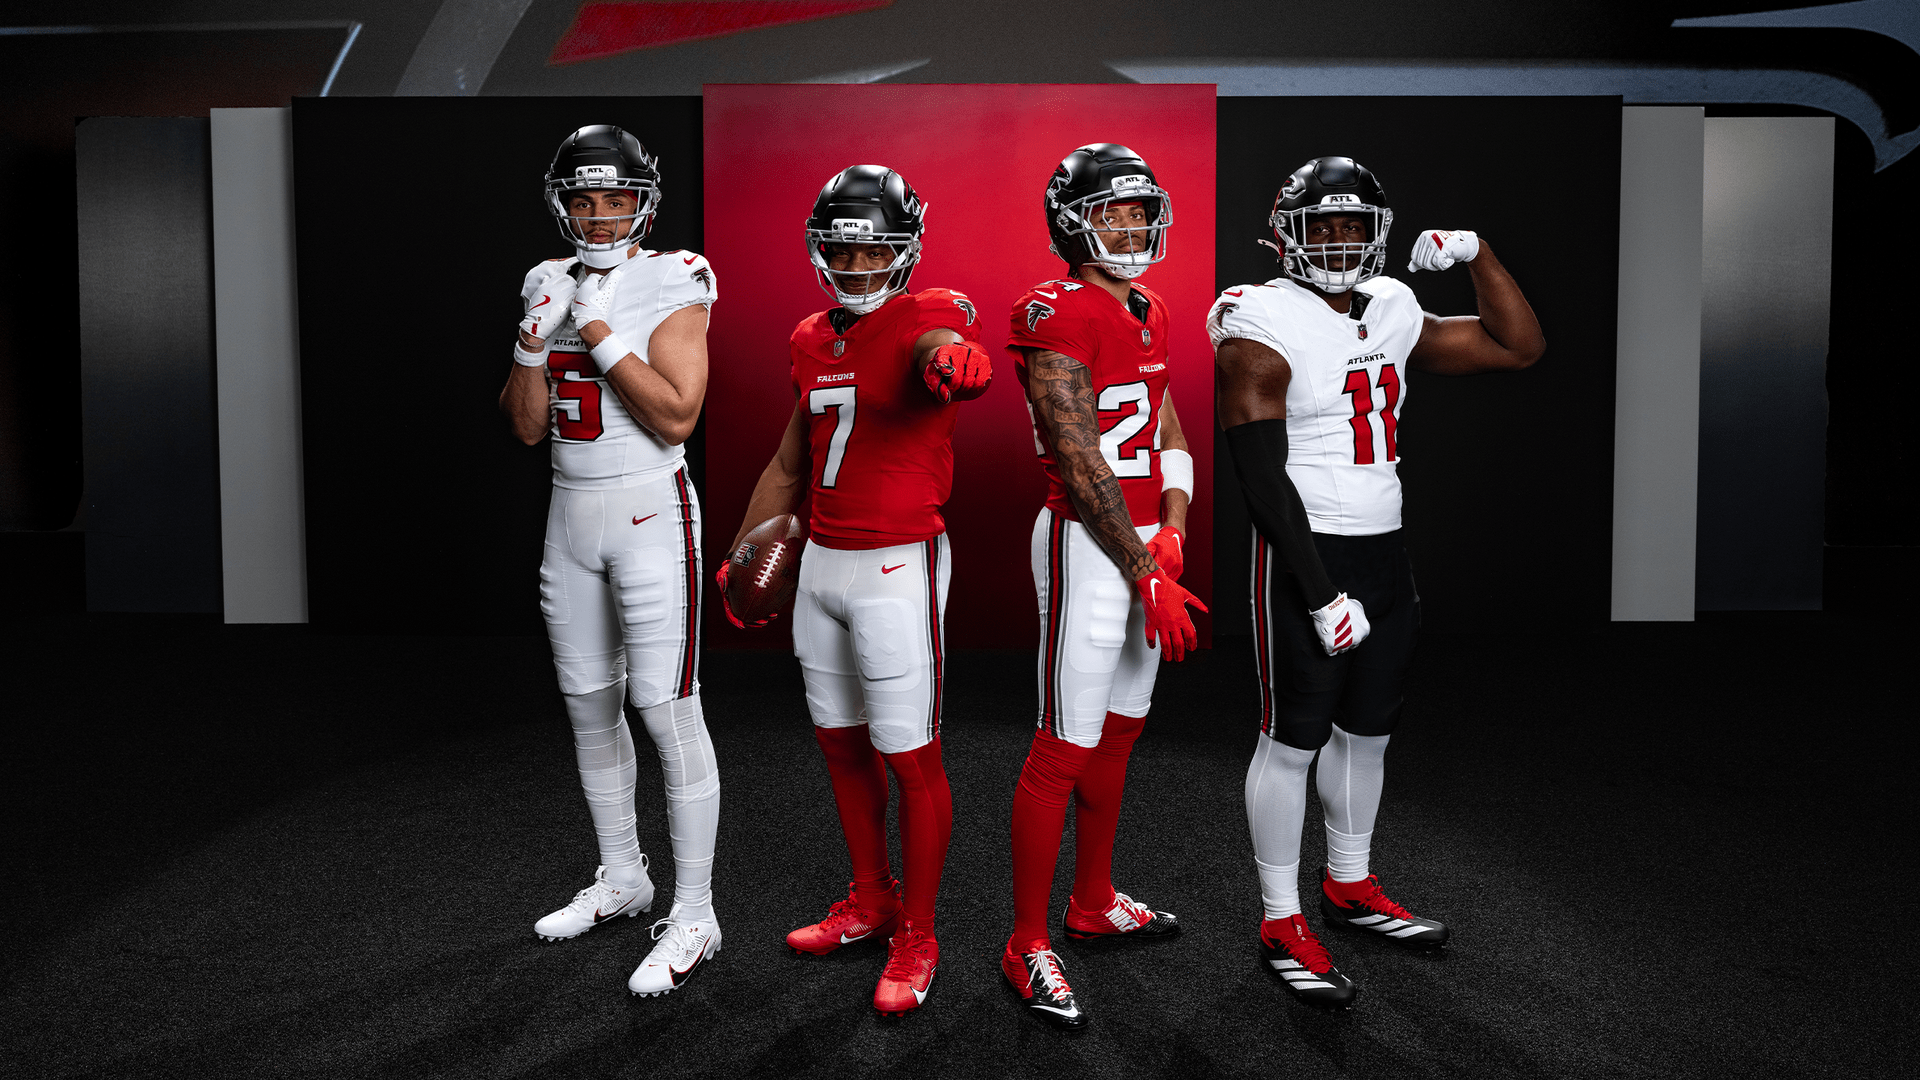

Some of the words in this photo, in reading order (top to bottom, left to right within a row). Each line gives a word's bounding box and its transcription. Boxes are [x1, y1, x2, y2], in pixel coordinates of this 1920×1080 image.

[1329, 195, 1353, 203] ATL
[553, 339, 584, 347] ATLANT
[1347, 352, 1386, 365] ATLANTA
[816, 372, 855, 383] FALCONS
[547, 350, 604, 441] 5
[1341, 363, 1400, 465] 11
[809, 384, 859, 489] 7
[1105, 905, 1141, 932] NIKE
